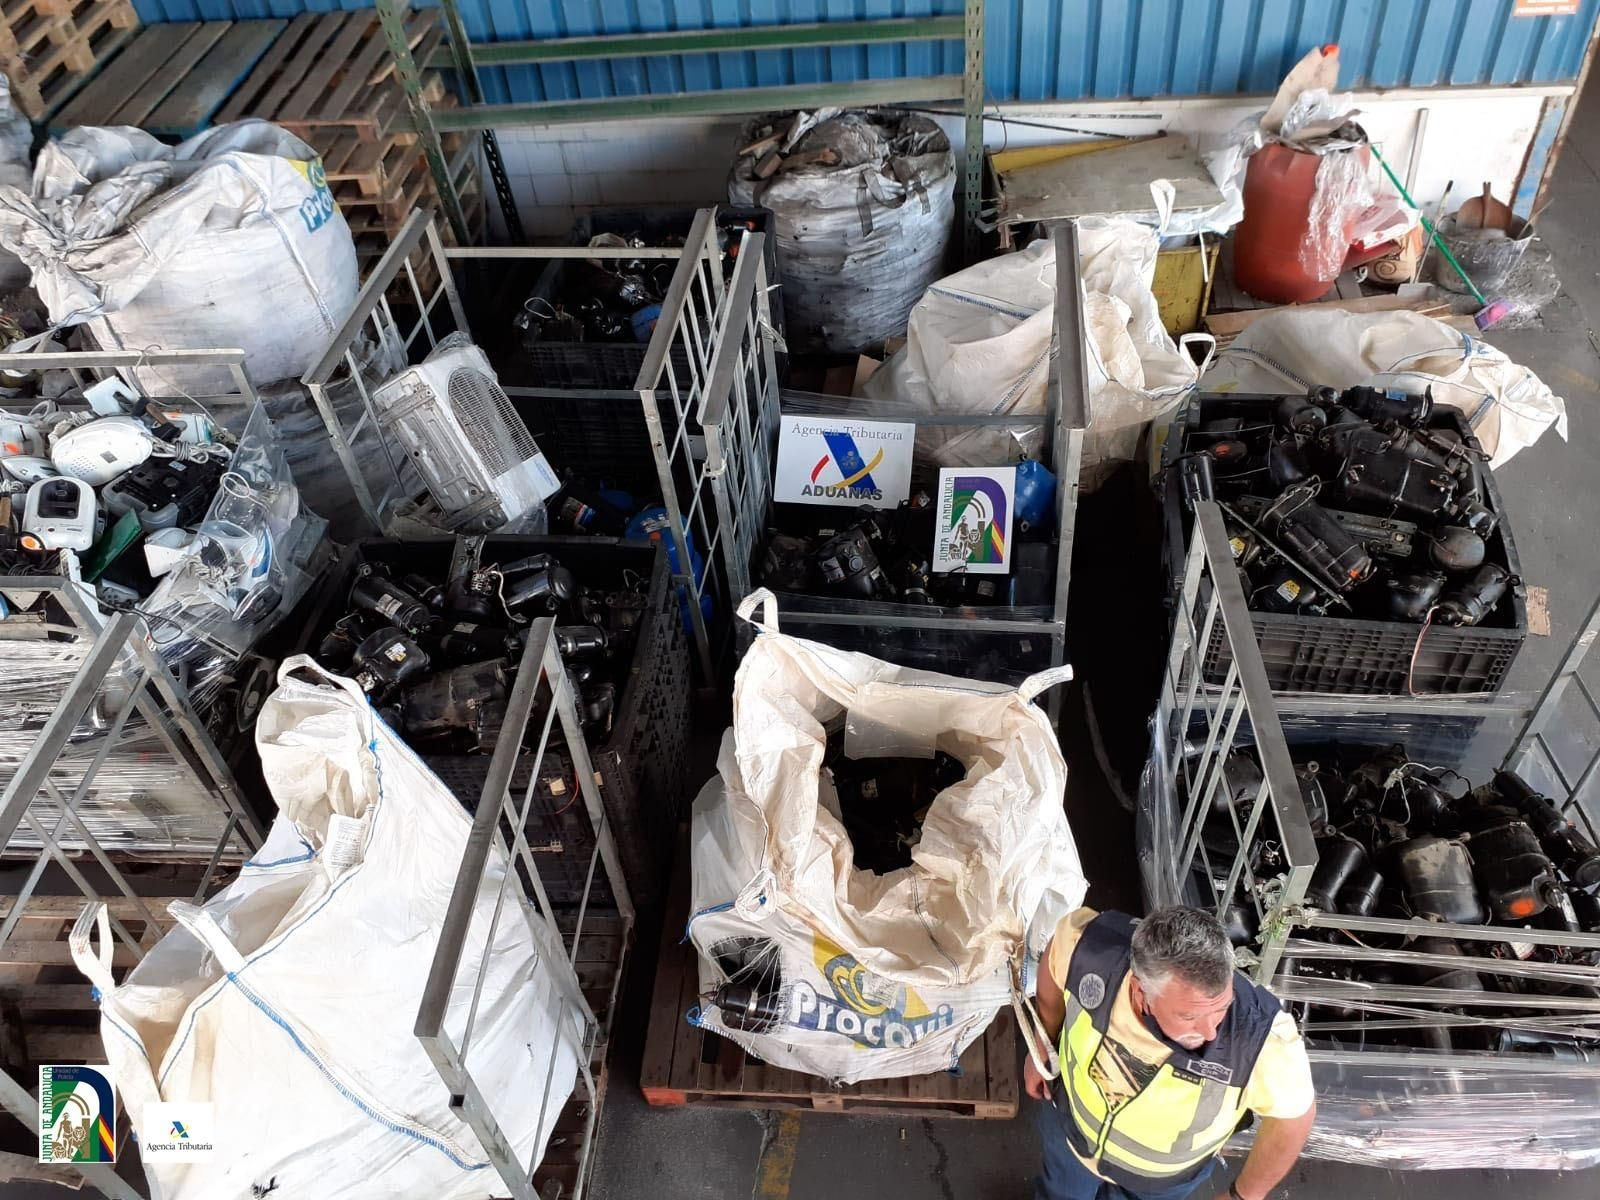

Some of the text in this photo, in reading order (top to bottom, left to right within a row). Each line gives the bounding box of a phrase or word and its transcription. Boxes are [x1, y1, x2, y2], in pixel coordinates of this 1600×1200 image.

[300, 188, 334, 231] Pro
[792, 423, 903, 440] Agencia Tributaria
[801, 484, 883, 500] ADUANAS
[941, 524, 951, 533] DE
[939, 537, 950, 563] JUNTA
